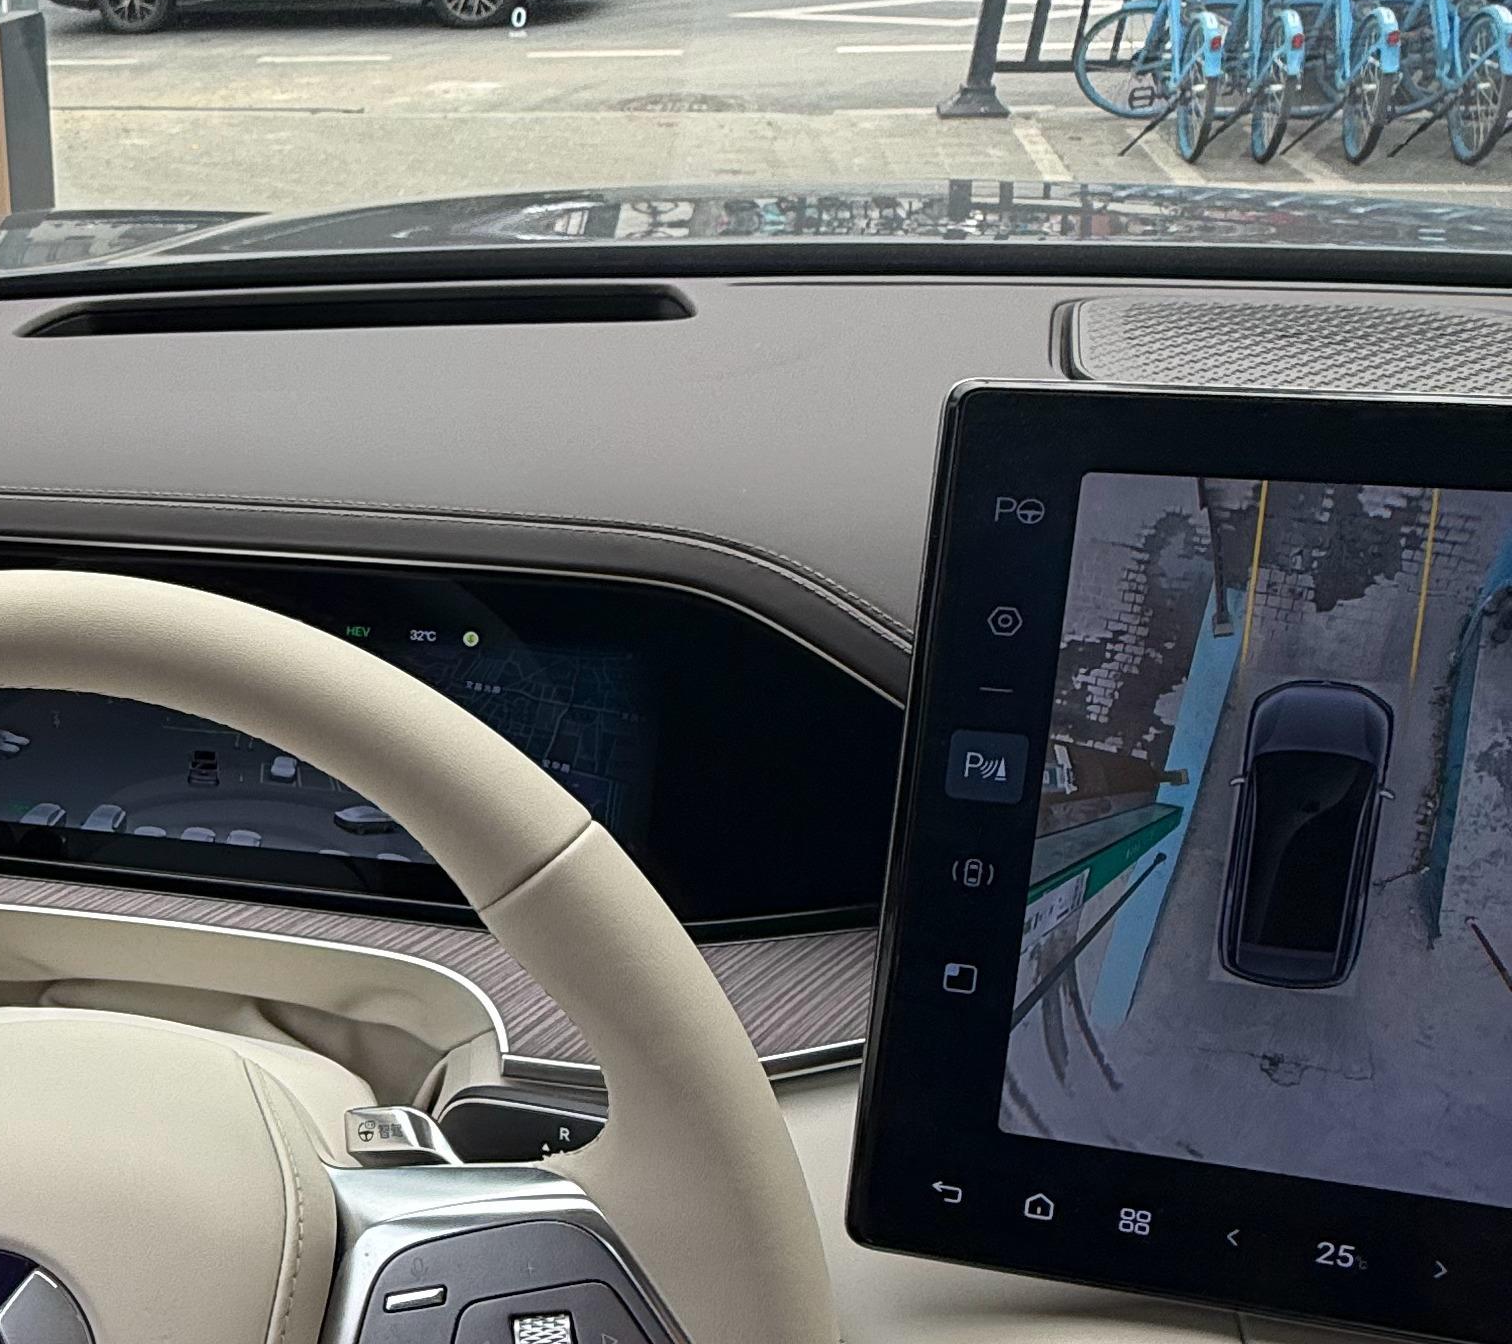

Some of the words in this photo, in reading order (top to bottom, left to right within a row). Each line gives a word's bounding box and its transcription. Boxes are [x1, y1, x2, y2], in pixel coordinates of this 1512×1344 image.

[511, 6, 527, 28] 0
[346, 625, 371, 638] HEV
[559, 1127, 571, 1142] R
